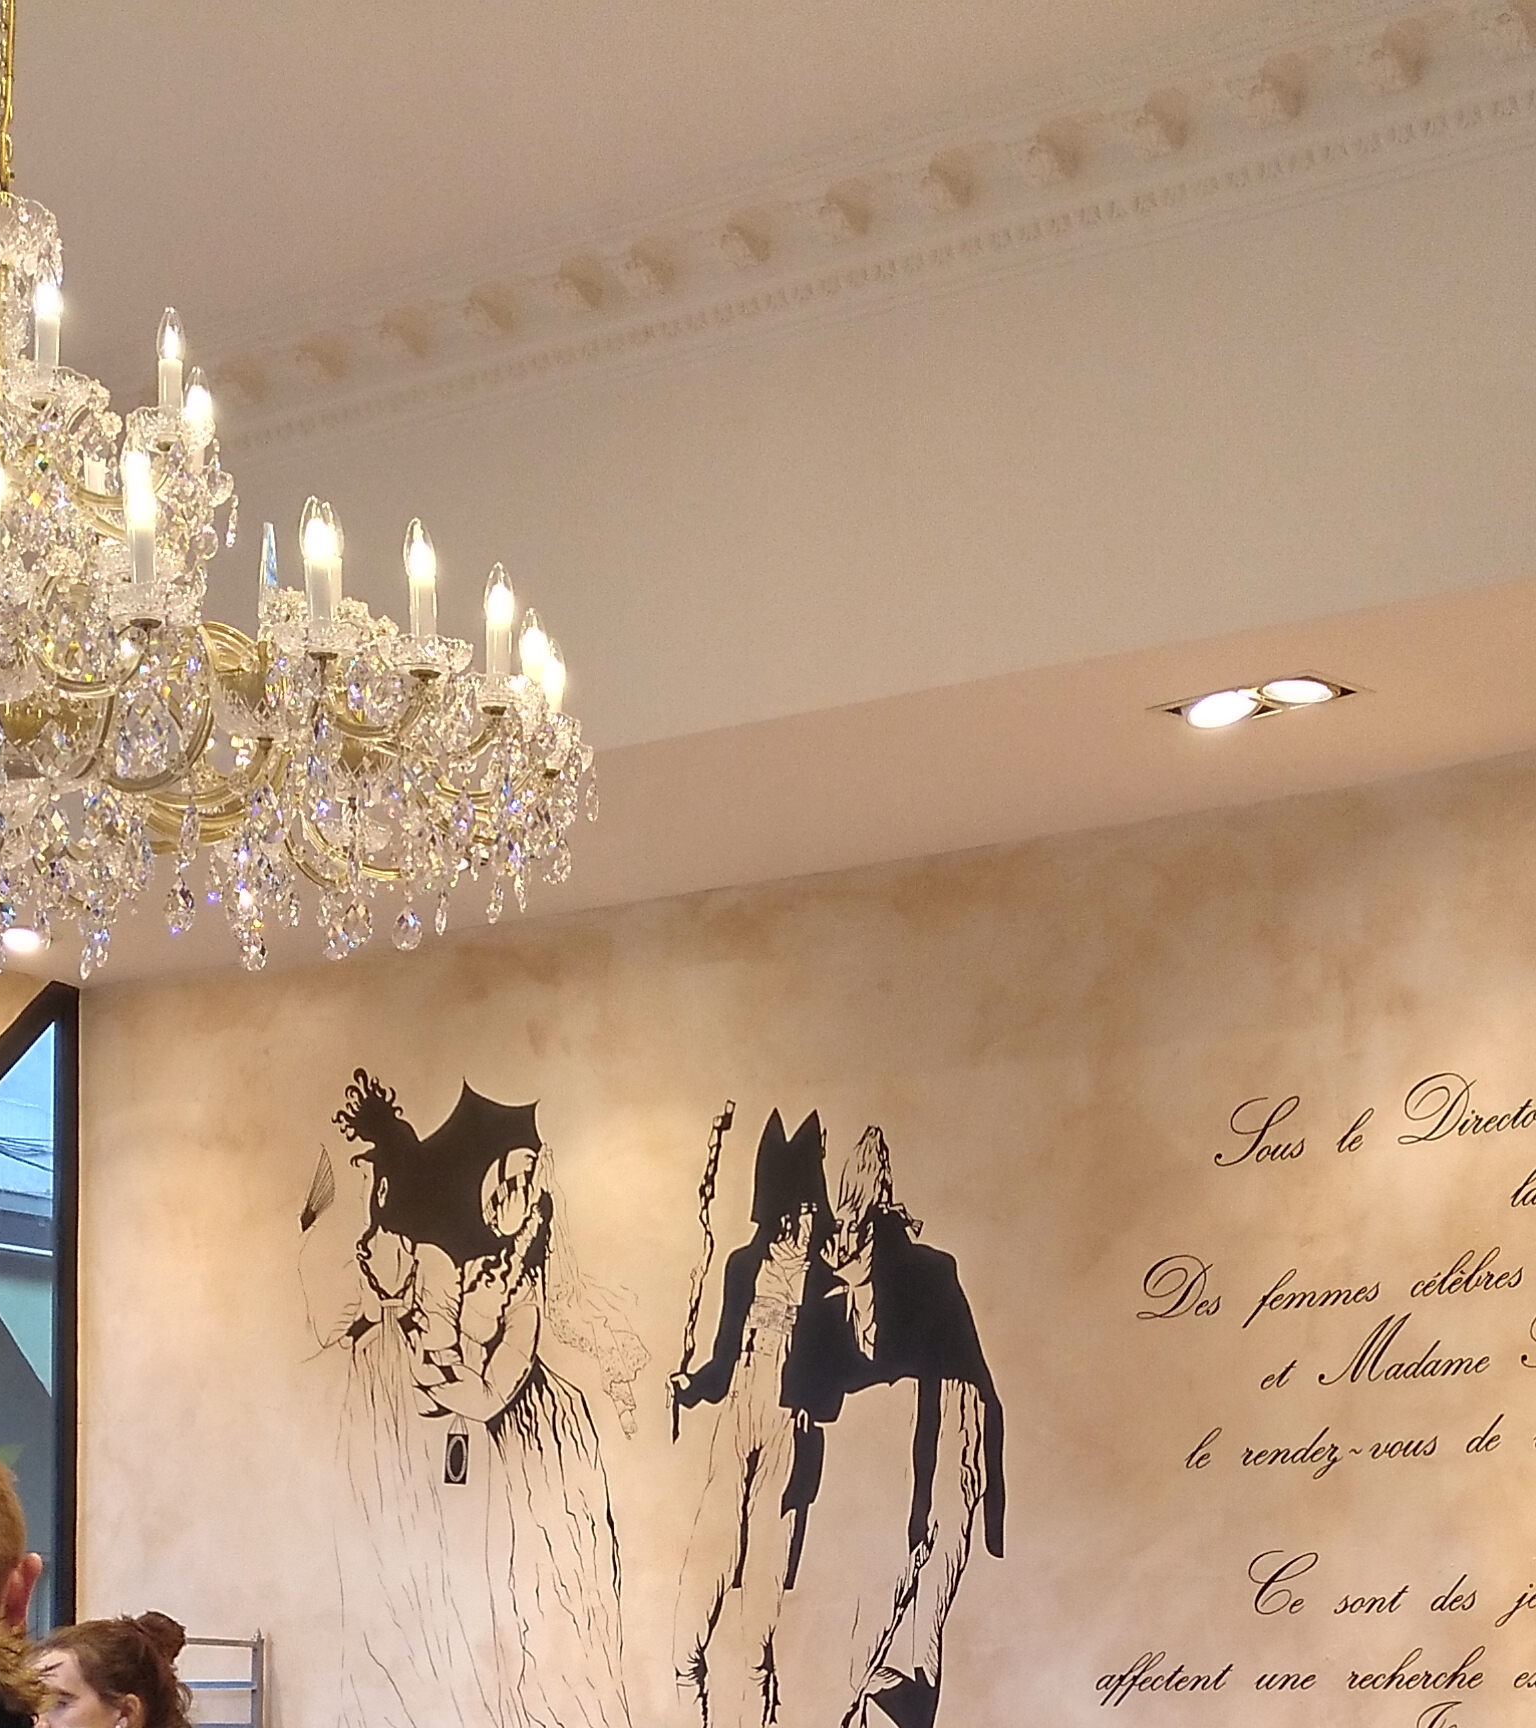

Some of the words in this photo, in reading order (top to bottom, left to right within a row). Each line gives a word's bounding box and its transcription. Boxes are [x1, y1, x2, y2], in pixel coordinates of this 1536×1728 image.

[1214, 1095, 1305, 1167] Sous
[1336, 1107, 1375, 1153] le
[1136, 1254, 1221, 1320] Des
[1242, 1268, 1380, 1329] femmes
[1410, 1246, 1523, 1298] célèbres
[1260, 1359, 1297, 1390] et
[1318, 1312, 1490, 1386] Madame
[1185, 1427, 1221, 1469] le
[1466, 1413, 1504, 1454] de
[1248, 1550, 1319, 1615] Ce
[1333, 1585, 1409, 1614] sont
[1430, 1574, 1477, 1611] des
[1095, 1651, 1234, 1707] affectent
[1254, 1670, 1316, 1690] une
[1346, 1645, 1485, 1692] recherche
